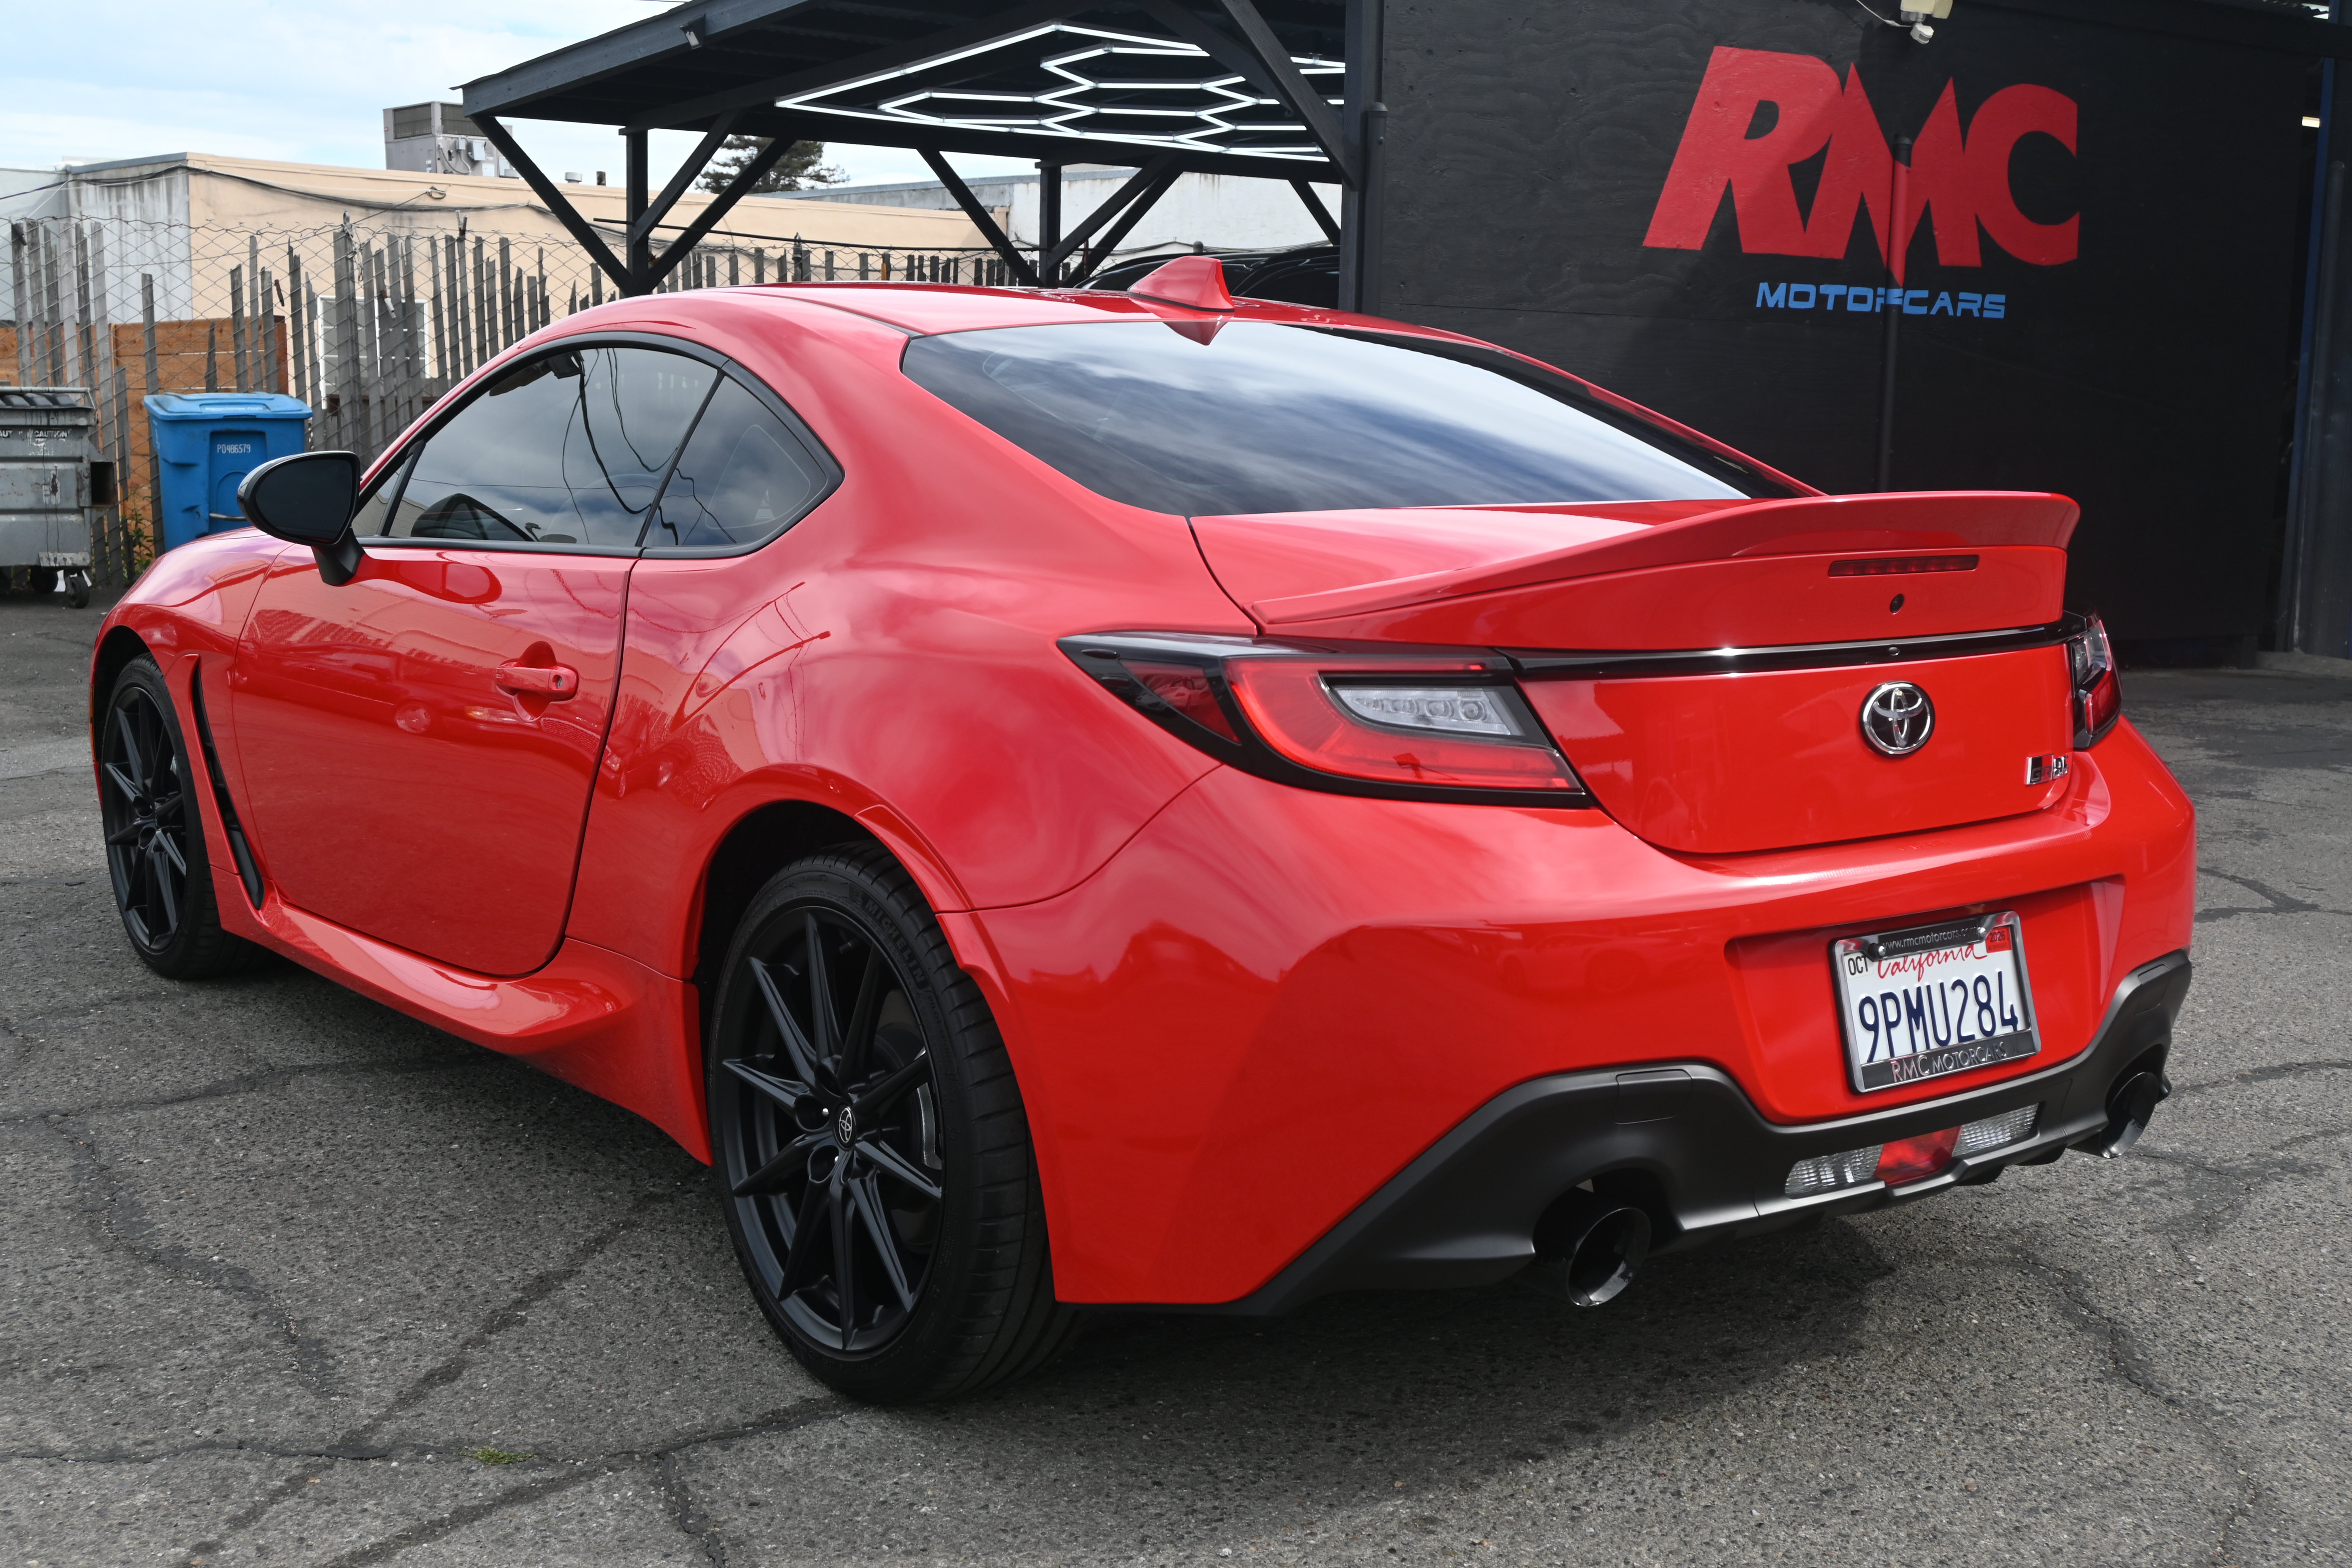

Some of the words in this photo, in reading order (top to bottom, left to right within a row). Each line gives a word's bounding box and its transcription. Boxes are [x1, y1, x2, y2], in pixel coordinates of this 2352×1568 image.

[1643, 45, 2080, 287] RMC
[1756, 282, 2006, 318] MOTORCARS
[865, 899, 928, 983] MICHELIN
[1989, 931, 2006, 942] 2026
[1848, 955, 1869, 976] OCT
[1859, 971, 2018, 1063] 9PMU284
[1891, 1054, 1930, 1083] RMC
[1932, 1041, 2007, 1071] MOTORCARS
